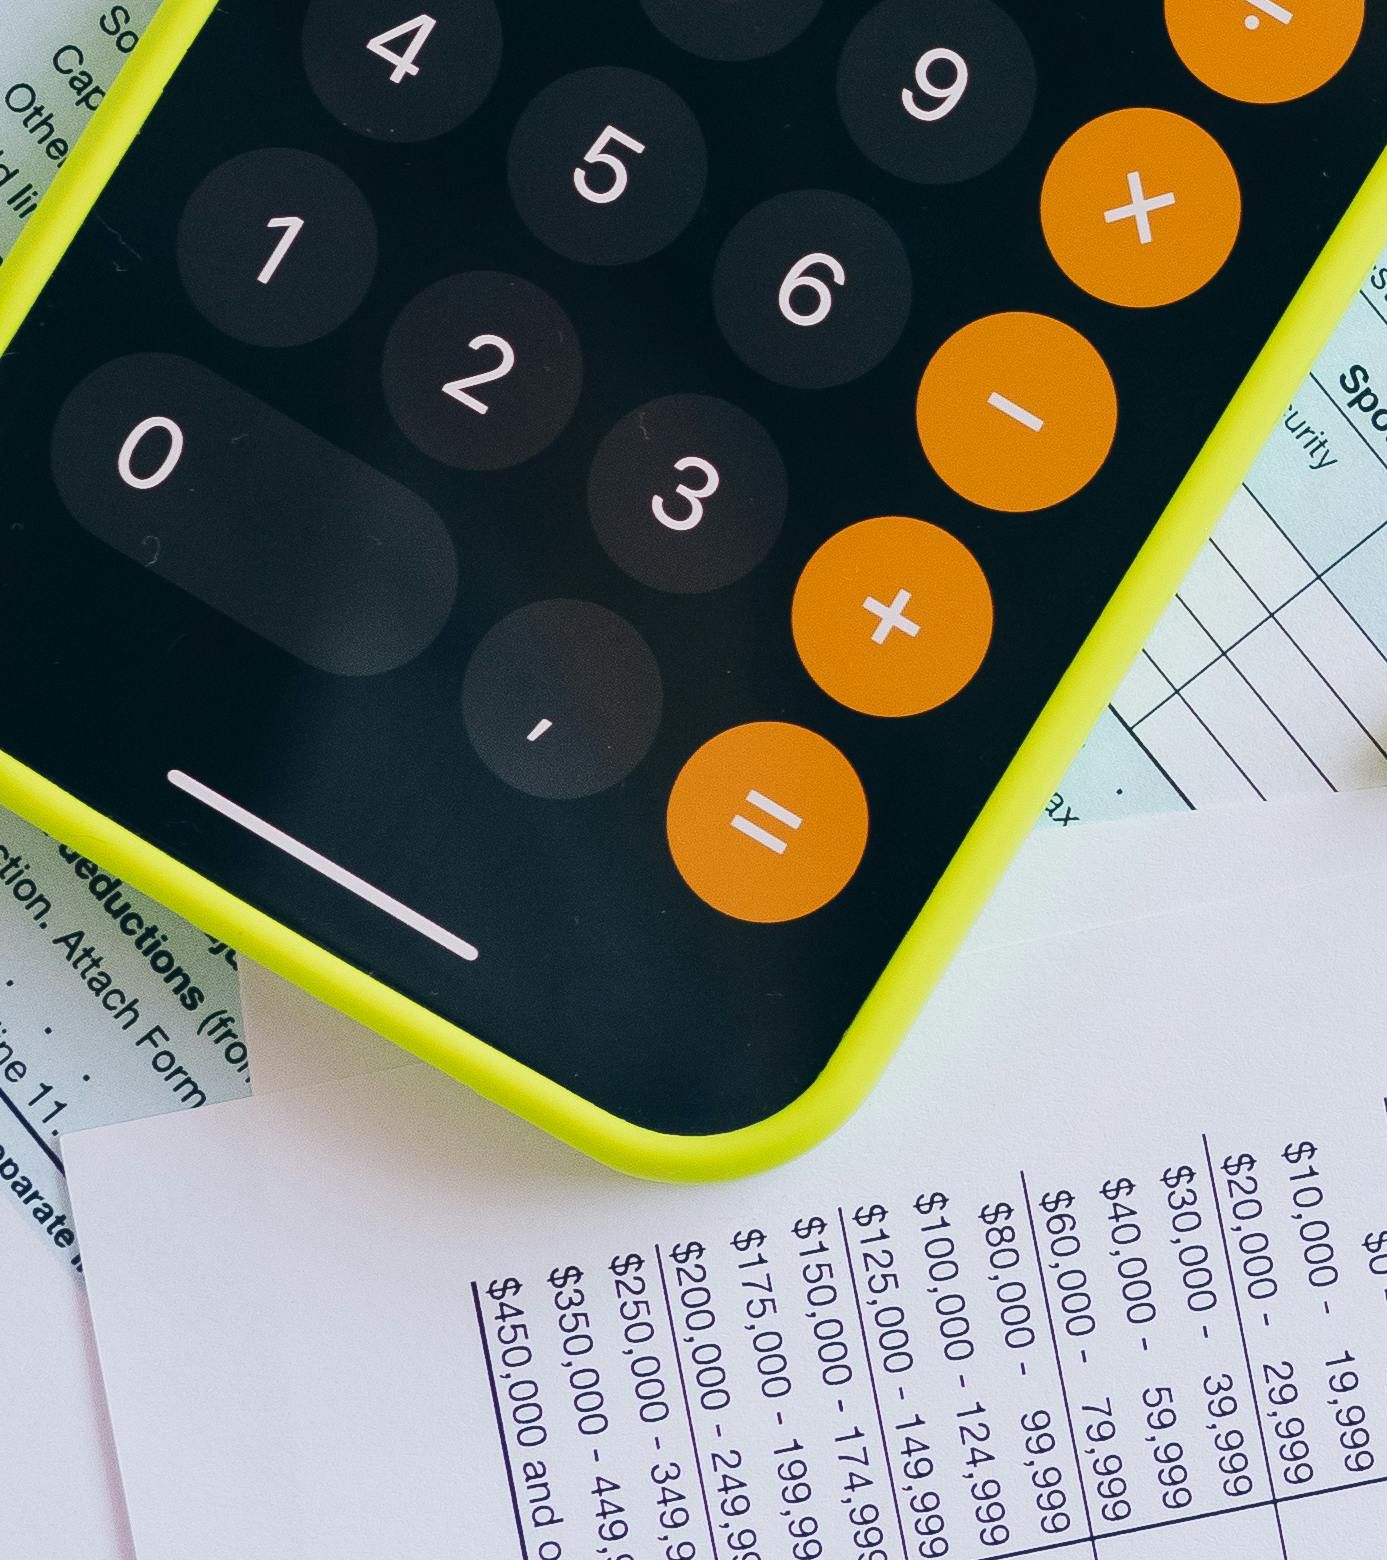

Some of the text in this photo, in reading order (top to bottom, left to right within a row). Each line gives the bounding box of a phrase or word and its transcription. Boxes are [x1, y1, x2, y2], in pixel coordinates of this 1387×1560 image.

[366, 13, 437, 84] 4
[901, 47, 969, 122] 9
[573, 124, 646, 204] 5
[256, 216, 305, 285] 1
[778, 252, 846, 327] 6
[441, 334, 515, 415] 2
[117, 416, 184, 490] 0
[651, 456, 720, 531] 3
[51, 929, 208, 1110] Attach Form
[27, 1081, 69, 1138] 11.
[484, 1276, 548, 1448] $450,000
[521, 1459, 565, 1528] and
